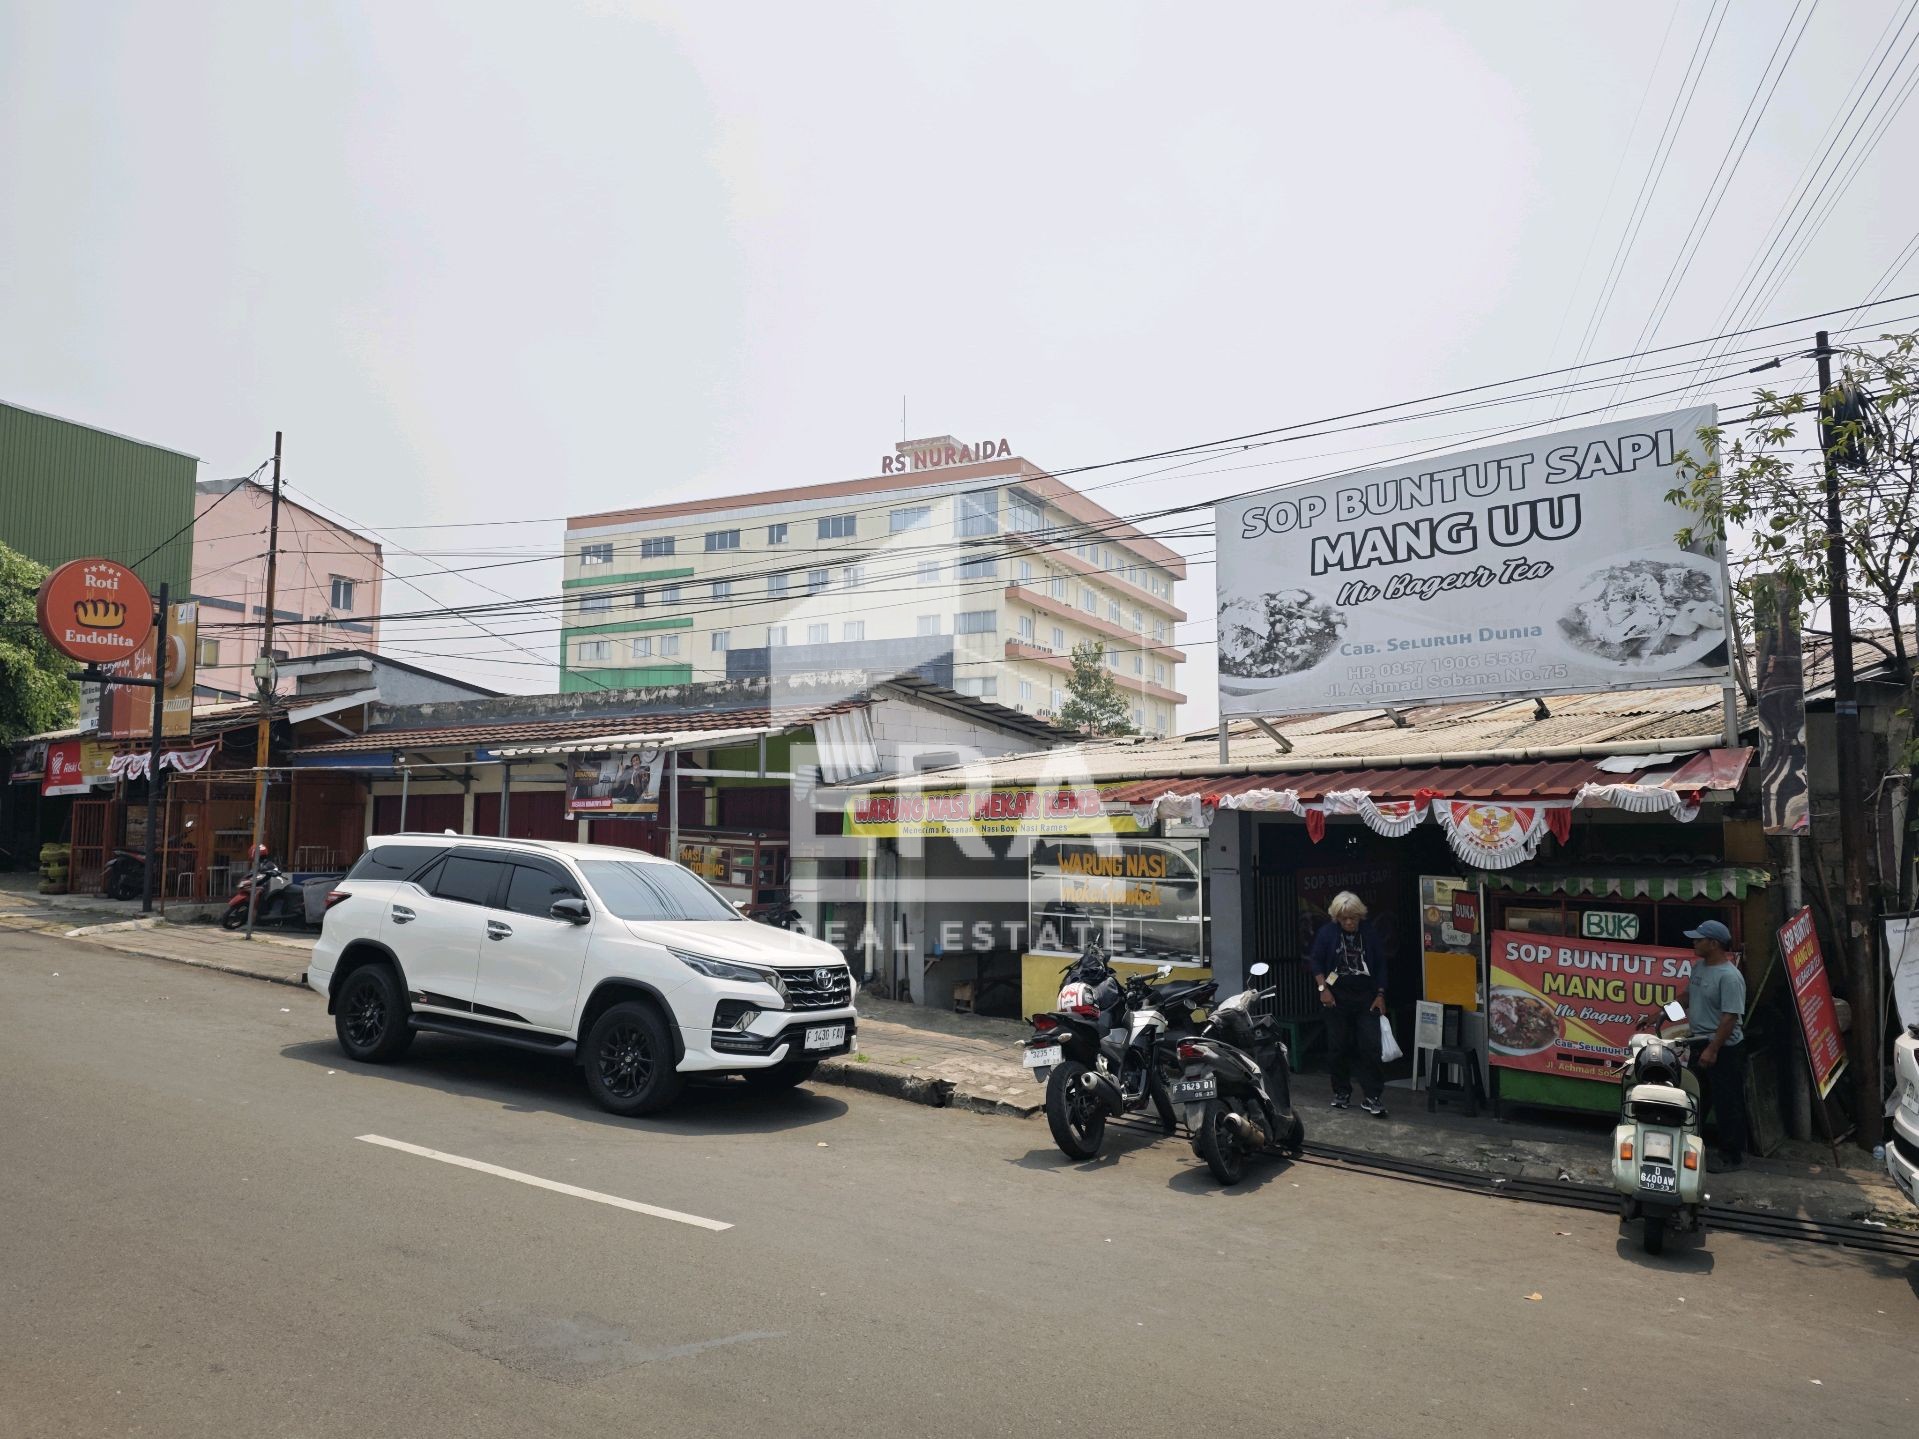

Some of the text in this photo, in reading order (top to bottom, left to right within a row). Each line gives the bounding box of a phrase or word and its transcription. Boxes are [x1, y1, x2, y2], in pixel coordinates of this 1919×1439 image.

[882, 438, 1012, 473] RS NURAIDA
[1242, 428, 1674, 539] SOP BUNTUT SAPI
[1311, 493, 1581, 576] MANG UU
[85, 574, 119, 590] Roti
[1336, 556, 1554, 606] Nu Bageur Tea
[65, 630, 134, 647] Endolita
[1379, 660, 1427, 677] 0857
[1431, 655, 1480, 672] 1906
[1485, 649, 1536, 667] 5587
[1351, 676, 1422, 695] Achmad
[1428, 671, 1499, 689] Sobana
[854, 796, 924, 823] WARUNG
[926, 792, 971, 821] NASI
[974, 790, 1040, 820] MEKAR
[903, 826, 940, 834] Menerima
[981, 824, 998, 833] Nasi
[1020, 824, 1038, 832] Nasi
[1040, 824, 1068, 832] Rames
[1057, 852, 1167, 878] WARUNG NASI
[1455, 904, 1476, 919] BUKA
[1586, 912, 1637, 938] BUKA
[1505, 942, 1552, 964] SOP
[1557, 948, 1656, 975] BUNTUT
[1662, 957, 1692, 978] SA
[1543, 972, 1676, 1008] MANG UU
[1554, 1003, 1576, 1018] Nu
[1579, 1007, 1634, 1025] Bageur
[1558, 1063, 1595, 1075] Achmad
